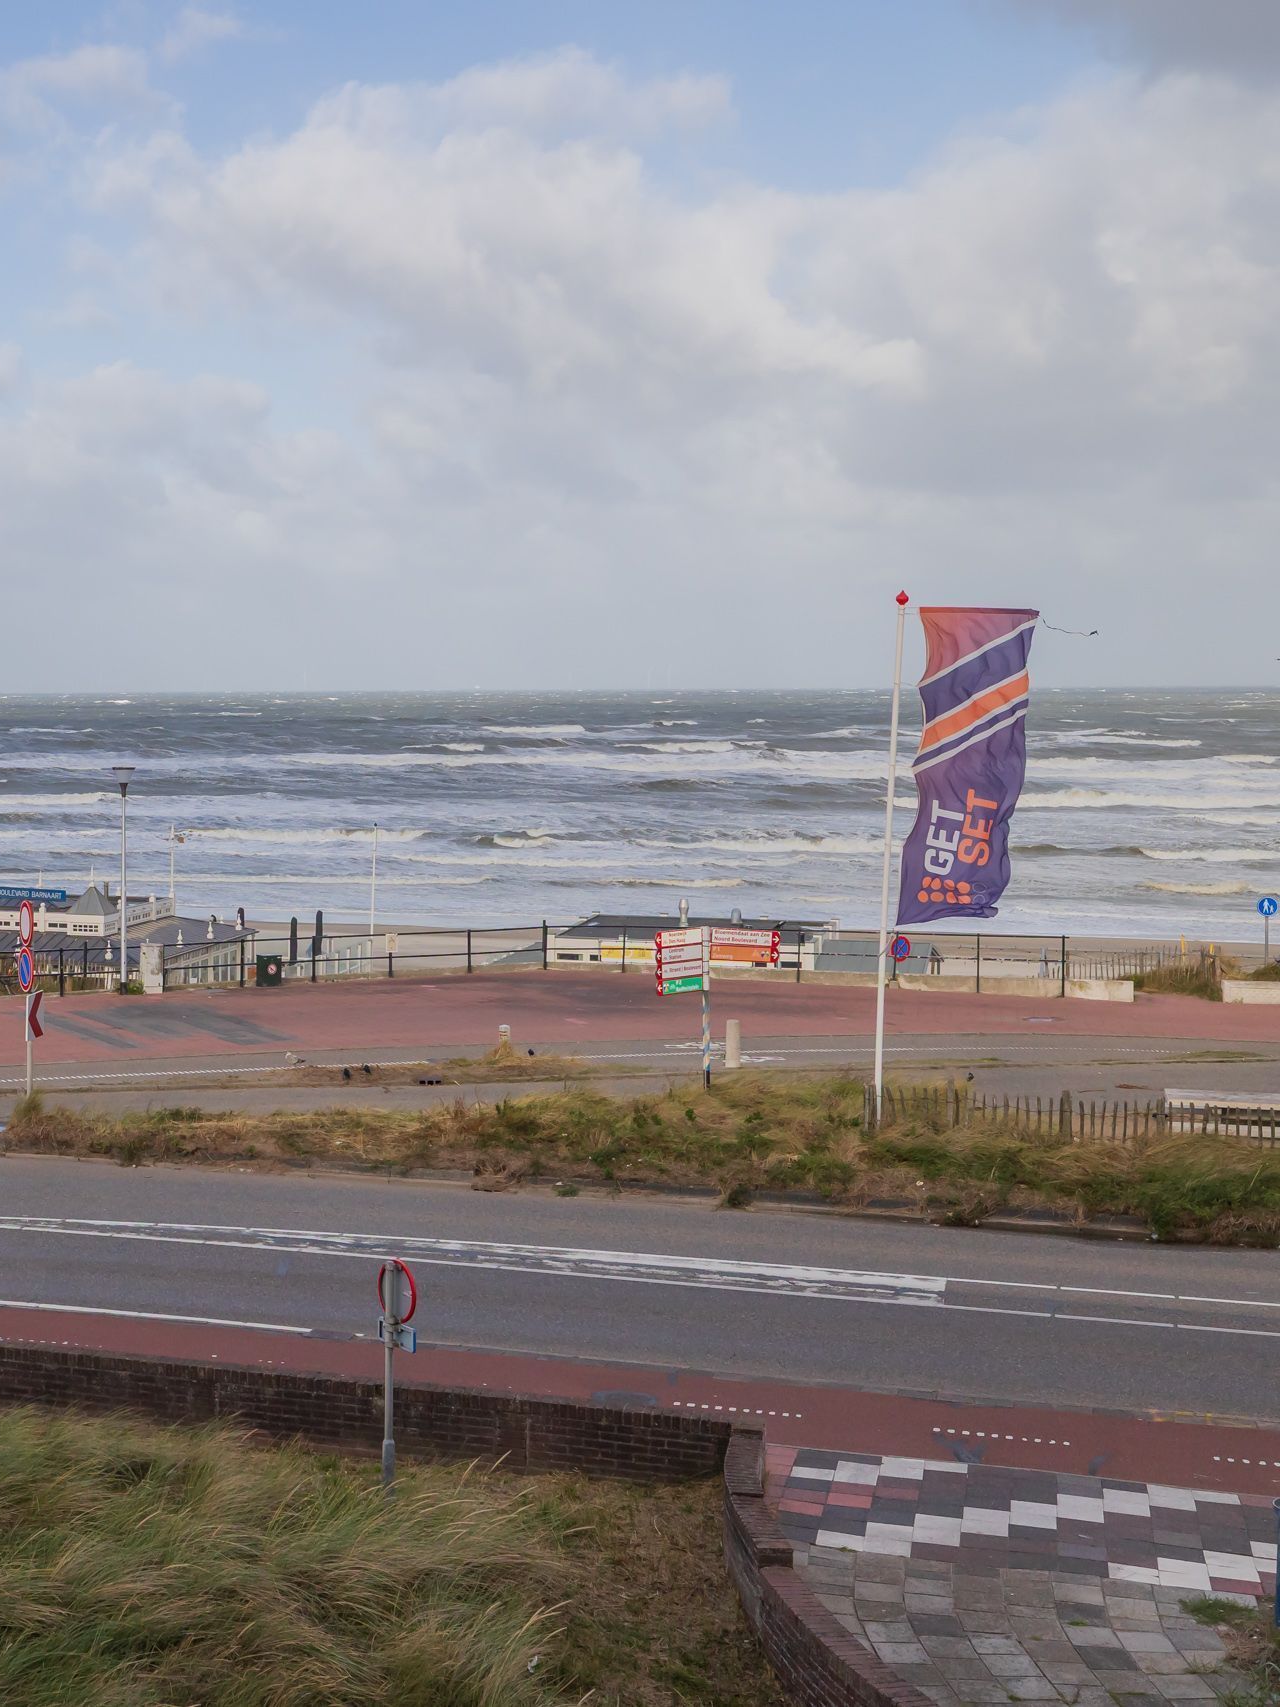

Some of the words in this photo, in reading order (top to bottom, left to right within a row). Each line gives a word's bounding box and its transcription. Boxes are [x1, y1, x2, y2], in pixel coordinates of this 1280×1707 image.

[924, 799, 965, 876] GET
[957, 788, 998, 866] SET
[31, 890, 62, 899] BARNAART
[714, 929, 749, 937] Bloemendaal
